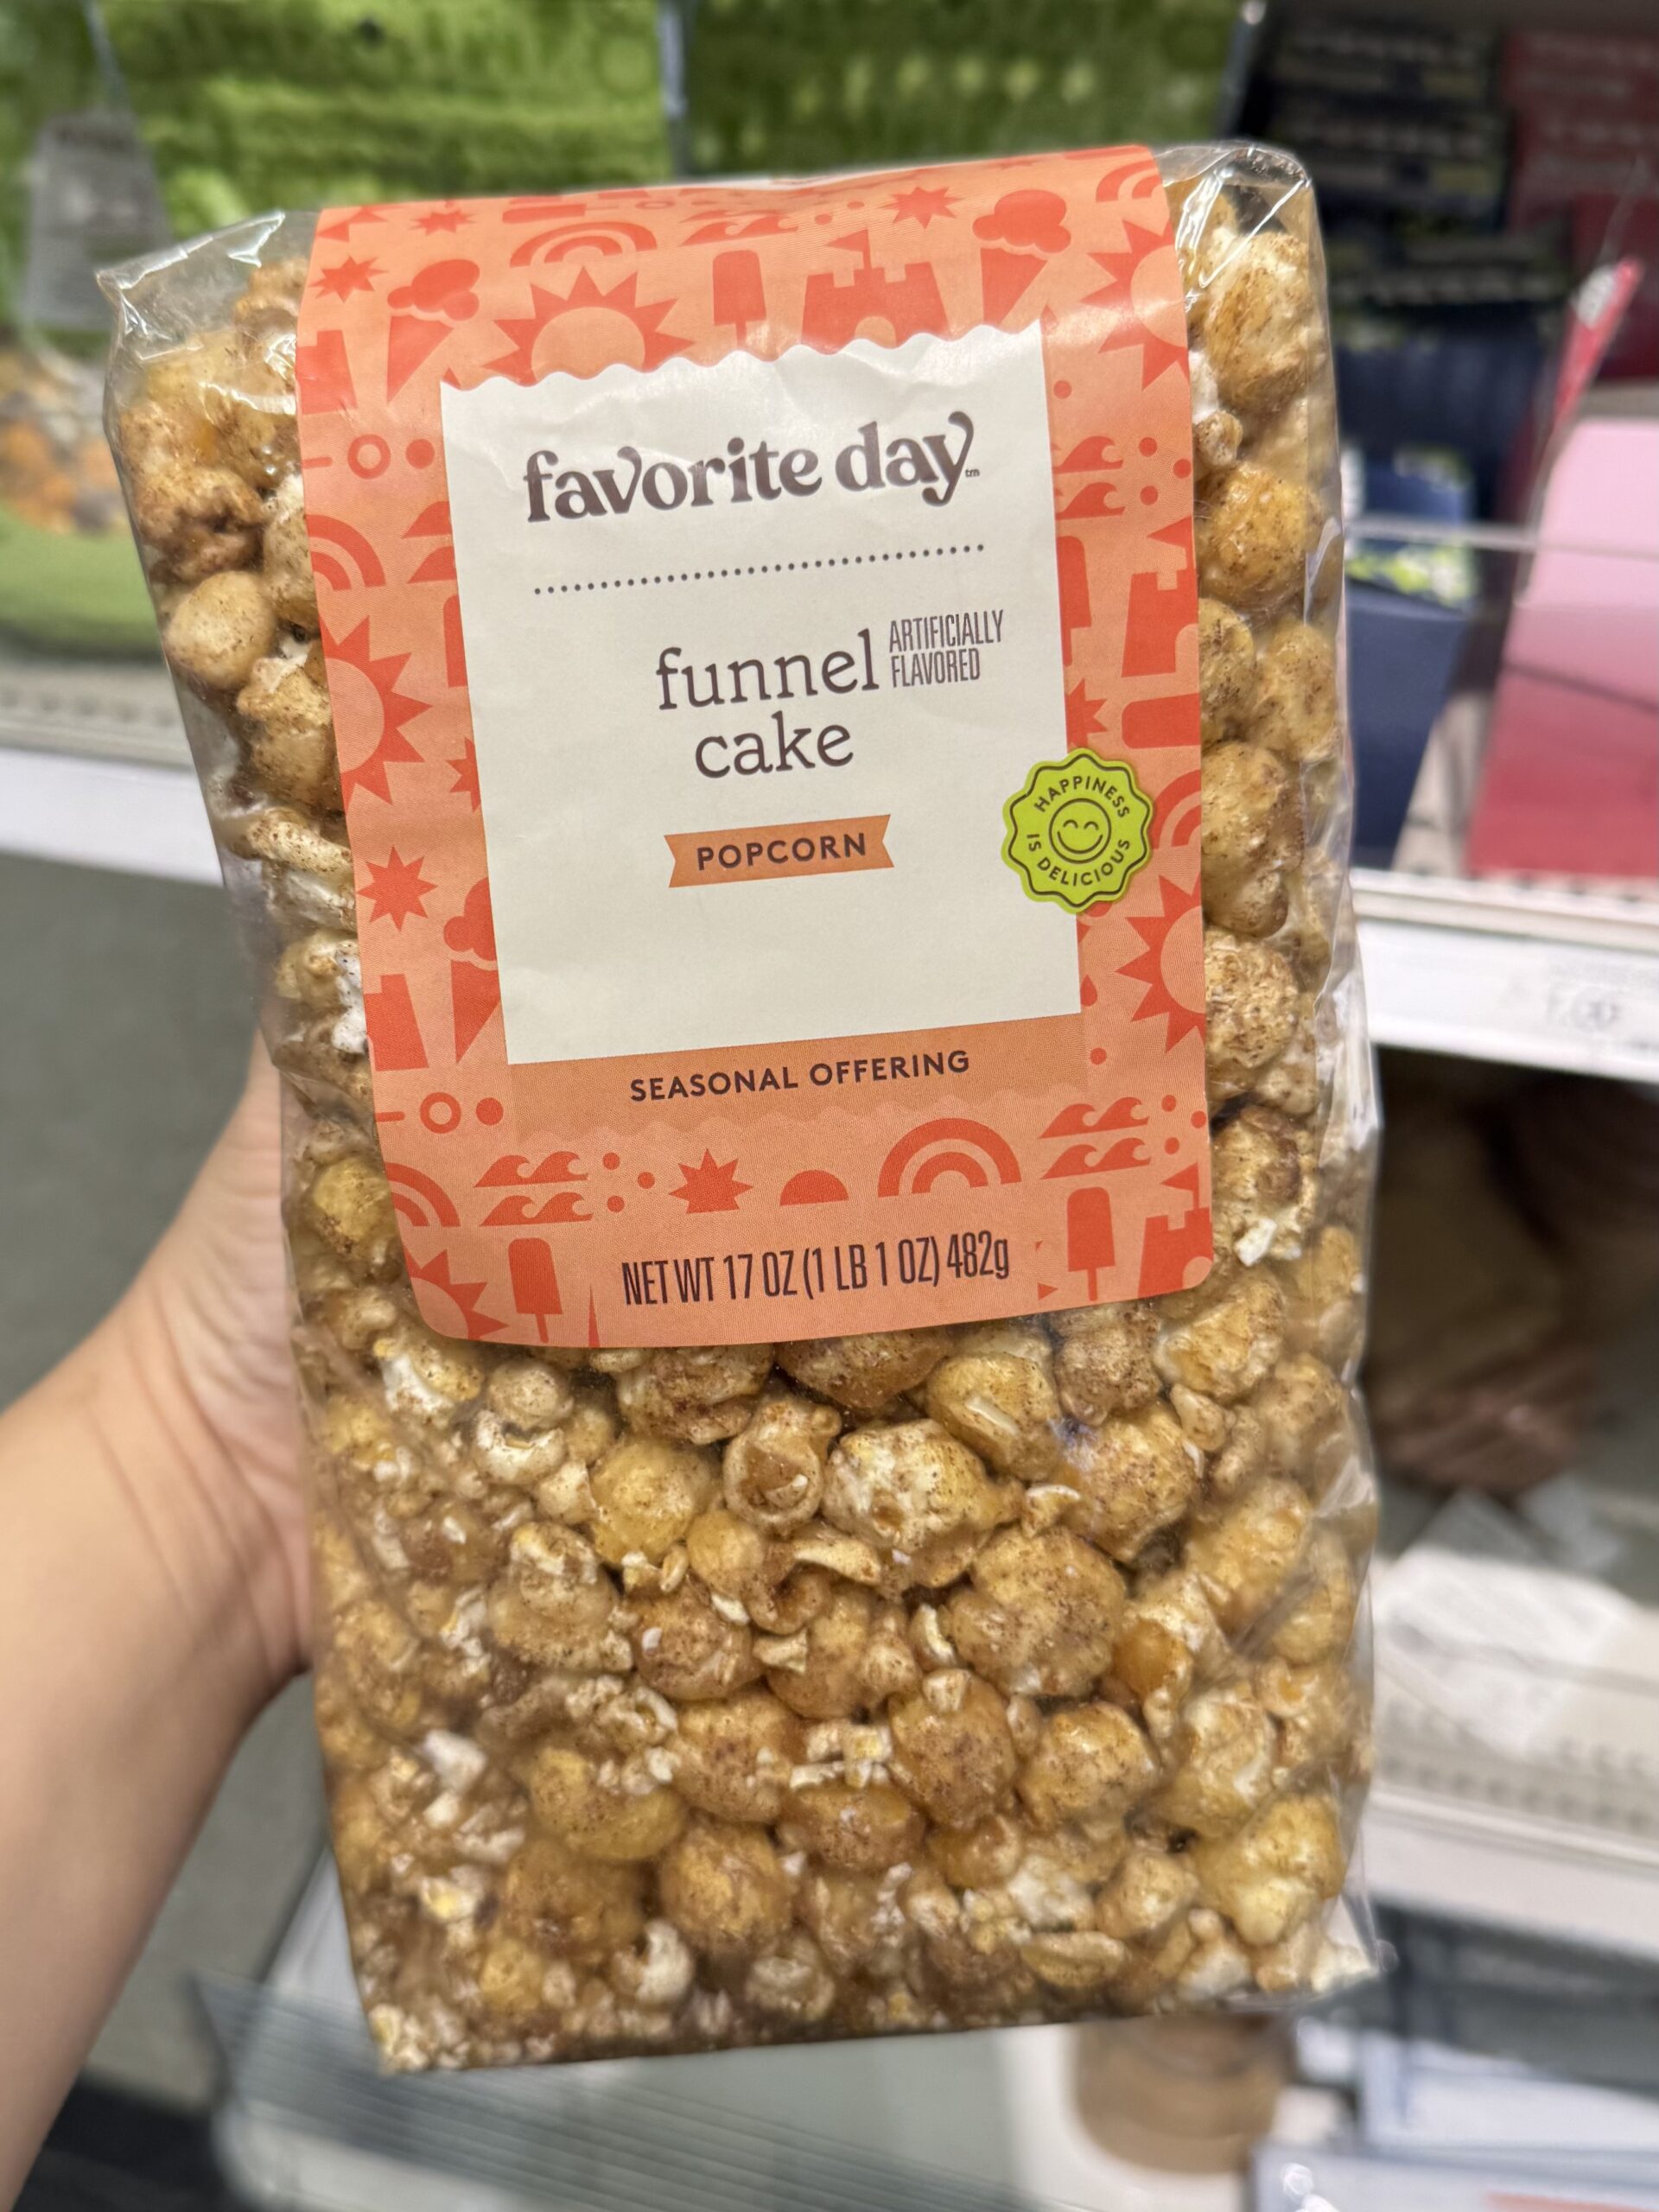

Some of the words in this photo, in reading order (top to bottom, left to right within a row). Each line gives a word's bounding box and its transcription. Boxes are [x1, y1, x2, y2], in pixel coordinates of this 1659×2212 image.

[524, 437, 823, 523] favorite
[835, 410, 974, 506] day
[889, 609, 1003, 653] ARTIFICIALLY
[656, 628, 880, 710] funnel
[891, 648, 981, 689] FLAVORED
[695, 710, 854, 779] cake
[1034, 776, 1130, 818] HAPPINESS
[696, 832, 867, 871] POPCORN
[1027, 833, 1042, 852] IS
[1037, 838, 1130, 887] DELICIOUS
[630, 1065, 798, 1102] SEASONAL
[809, 1050, 969, 1087] OFFERING
[621, 1259, 669, 1306] NET
[674, 1256, 715, 1302] WT
[723, 1254, 753, 1300] 17
[762, 1249, 798, 1296] OZ
[804, 1245, 825, 1300] (1
[834, 1243, 866, 1291] LB
[875, 1241, 887, 1287] 1
[898, 1236, 940, 1287] OZ)
[946, 1230, 1009, 1280] 482g
